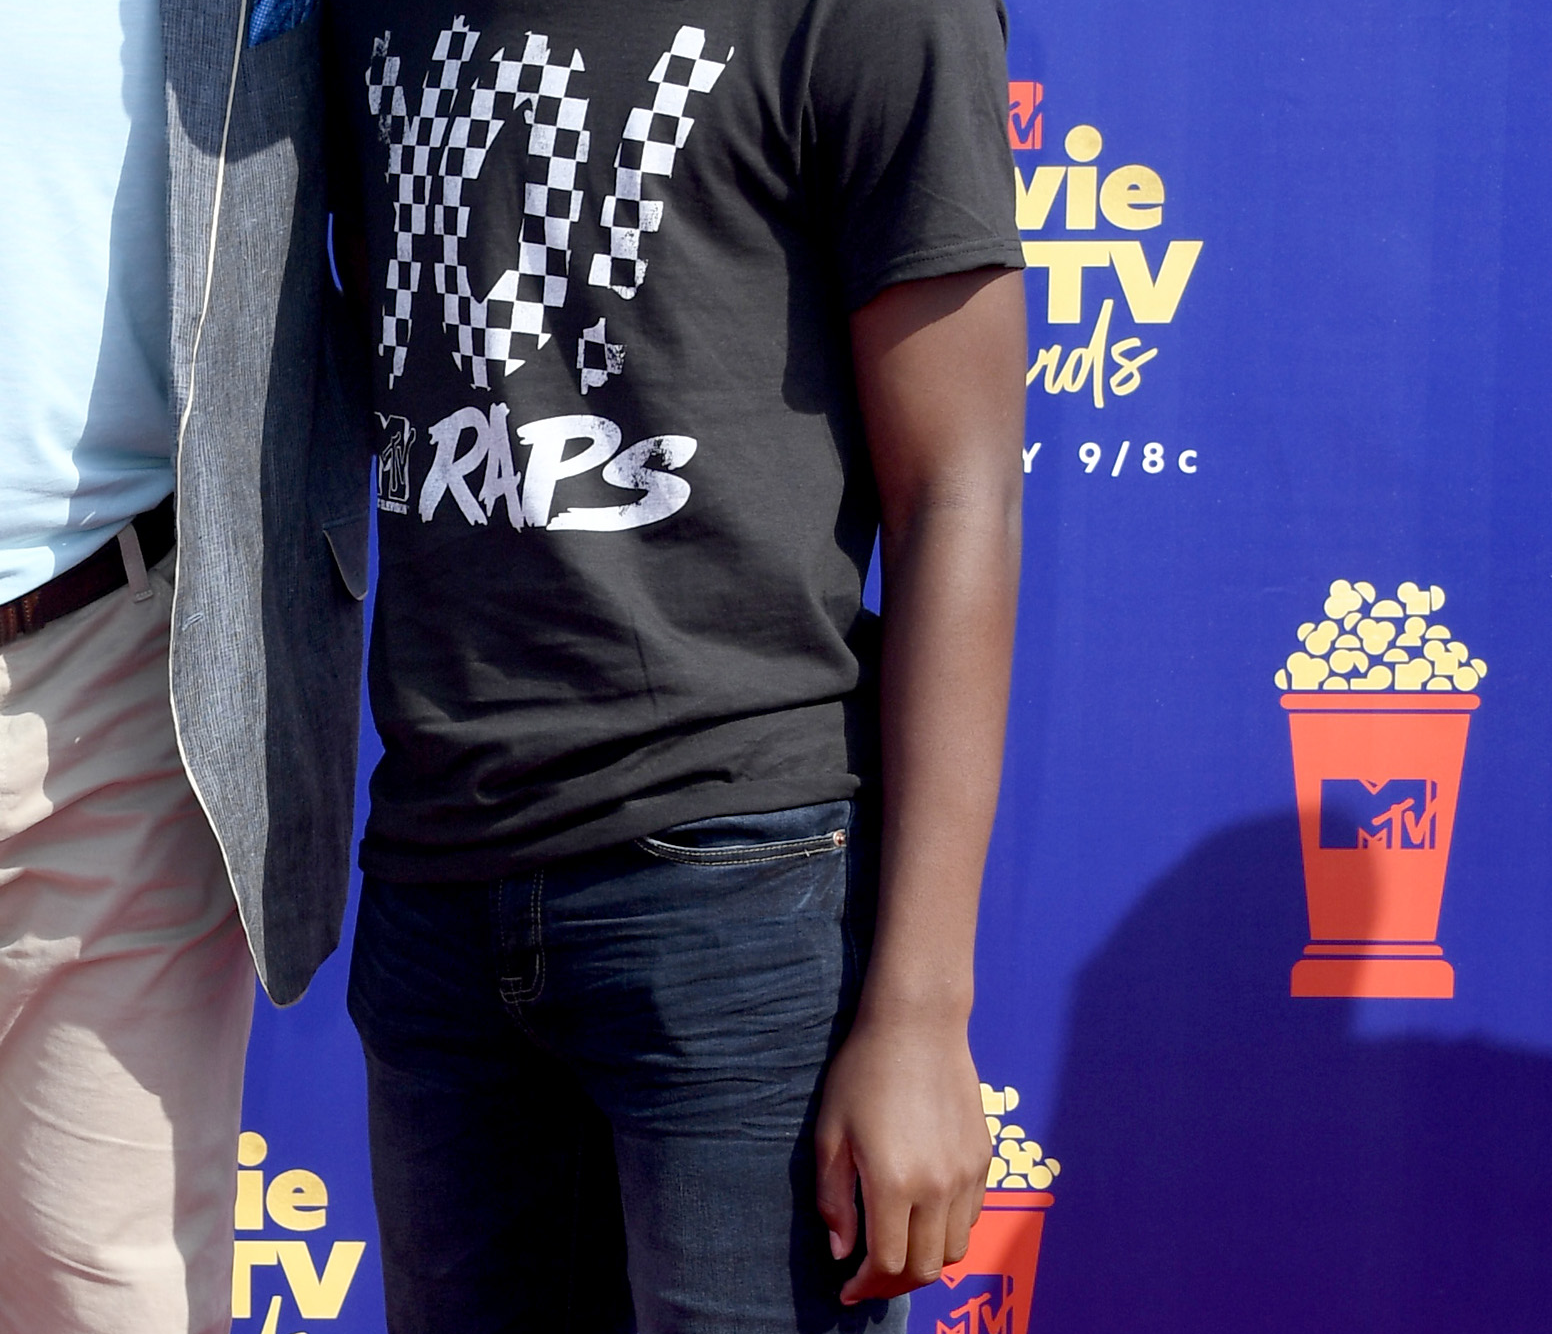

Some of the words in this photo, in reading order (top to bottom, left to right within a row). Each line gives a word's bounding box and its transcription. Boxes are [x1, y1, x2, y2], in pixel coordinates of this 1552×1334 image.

[365, 14, 735, 395] YO!
[1014, 124, 1165, 231] vie
[1021, 240, 1204, 324] TV
[418, 401, 698, 533] RAPS
[1078, 440, 1198, 477] 9/8c
[1320, 779, 1438, 849] MTV
